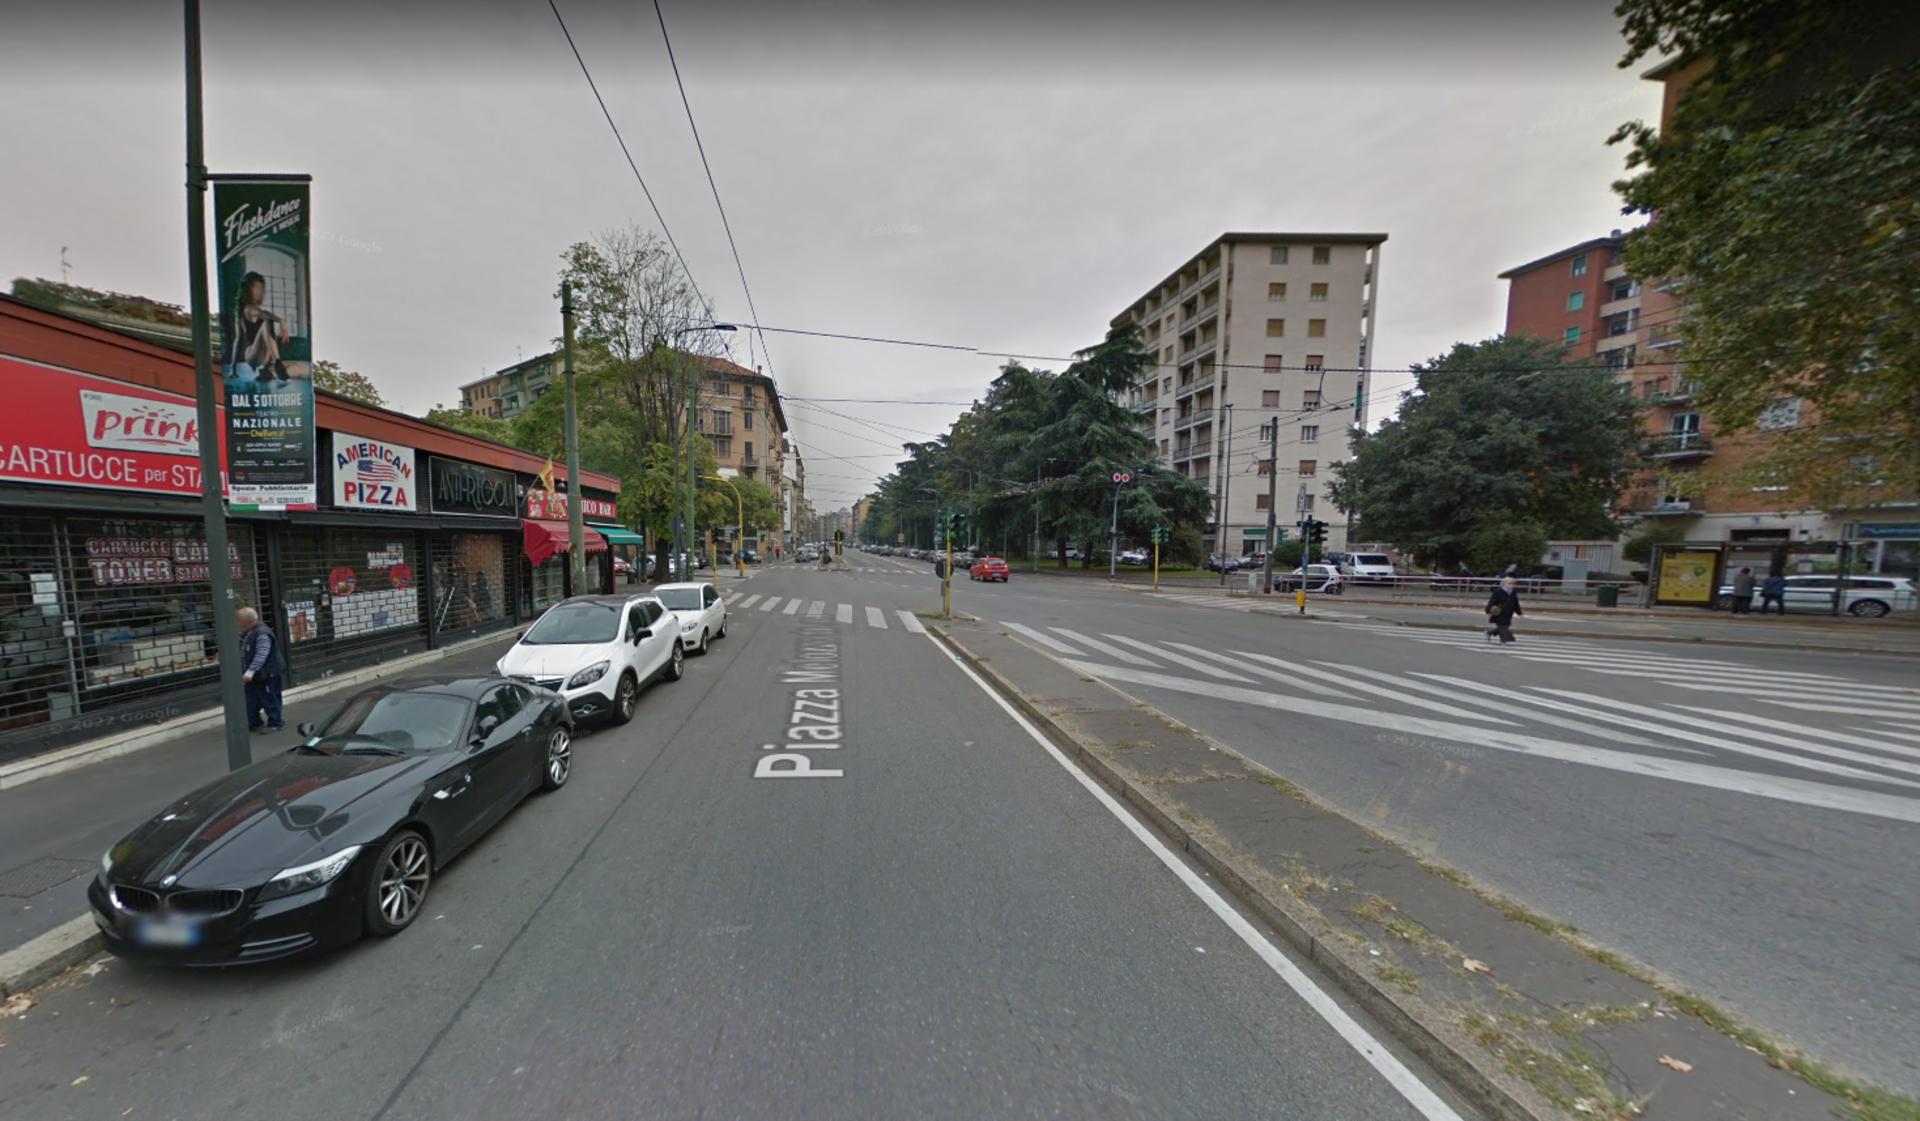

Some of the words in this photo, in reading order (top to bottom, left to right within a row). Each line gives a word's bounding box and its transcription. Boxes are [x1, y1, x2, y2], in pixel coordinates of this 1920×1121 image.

[224, 198, 300, 247] Flashdance
[232, 394, 251, 407] DAL
[253, 394, 260, 407] 5
[260, 392, 303, 407] OTTOBRE
[233, 417, 302, 428] NAZIONALE
[337, 443, 411, 479] AMERICAN
[144, 468, 167, 484] per
[344, 482, 408, 506] PIZZA
[87, 540, 170, 556] CARTUCCE
[174, 540, 240, 563] CAA
[91, 559, 173, 583] TONER
[225, 589, 235, 599] 2
